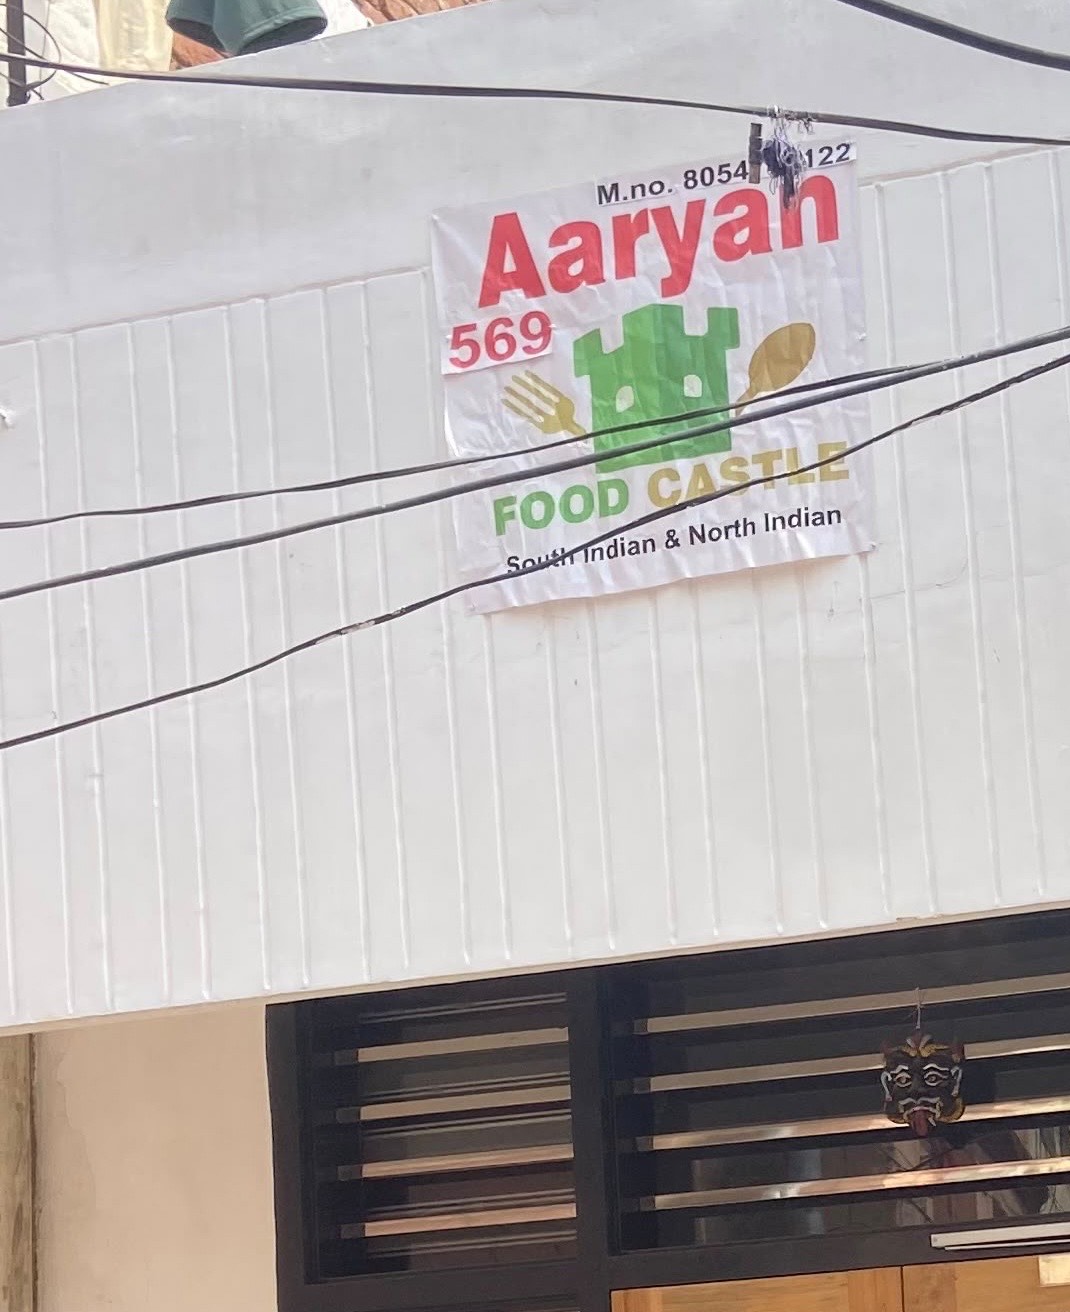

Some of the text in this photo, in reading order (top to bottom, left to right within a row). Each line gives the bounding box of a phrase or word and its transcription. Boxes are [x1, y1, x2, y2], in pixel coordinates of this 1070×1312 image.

[597, 143, 850, 206] M.no. 8054122
[478, 174, 840, 309] Aaryan
[449, 310, 552, 370] 569
[493, 441, 850, 537] FOOD CASTLE
[506, 507, 842, 574] South Indian & North Indian
